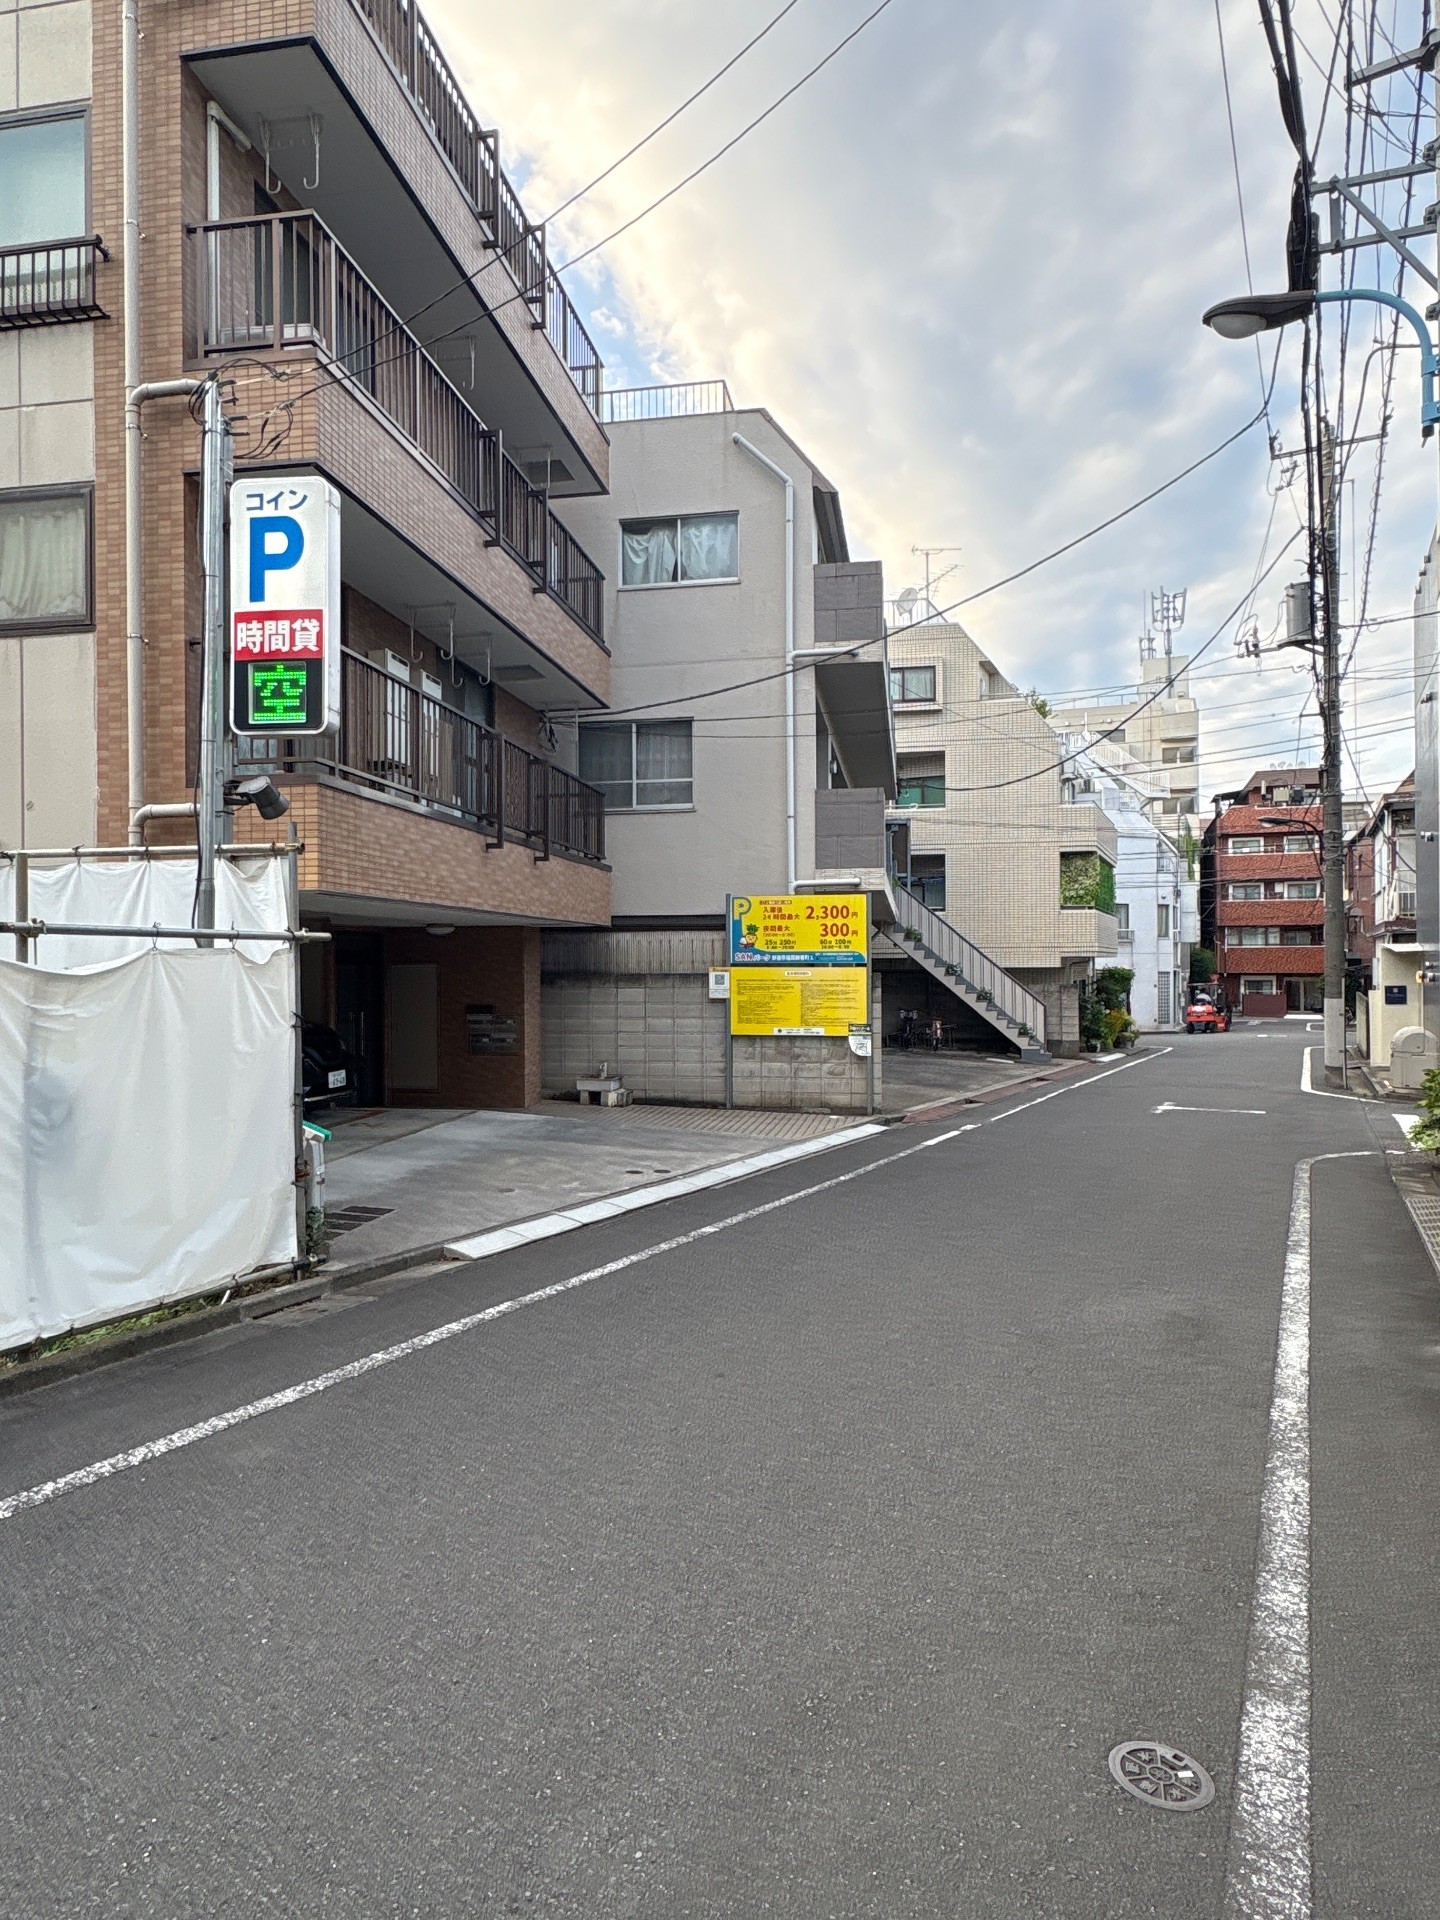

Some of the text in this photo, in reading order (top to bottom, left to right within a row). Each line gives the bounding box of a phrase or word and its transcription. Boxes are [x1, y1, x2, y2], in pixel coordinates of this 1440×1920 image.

[246, 490, 308, 511] コイン
[249, 515, 305, 603] P
[236, 618, 321, 653] 時間貸
[253, 664, 307, 721] 空
